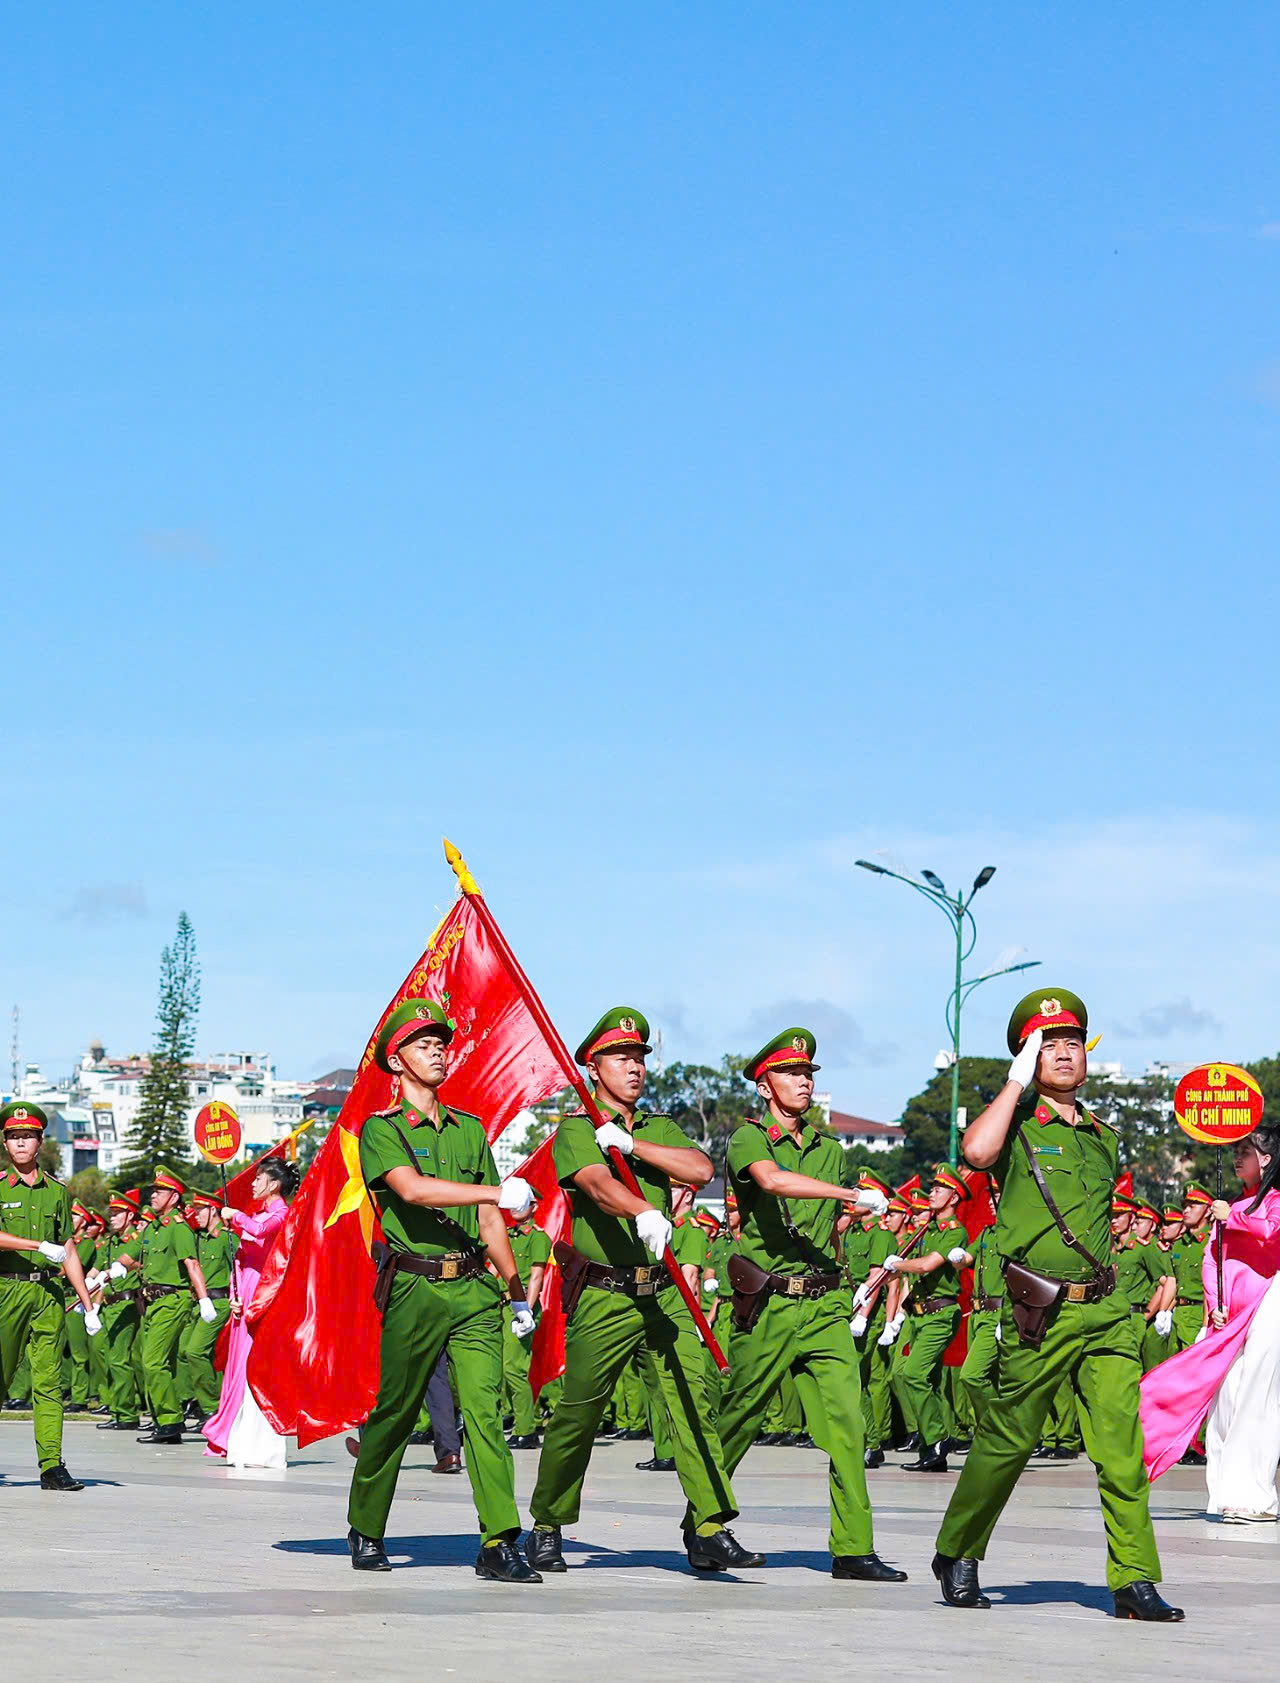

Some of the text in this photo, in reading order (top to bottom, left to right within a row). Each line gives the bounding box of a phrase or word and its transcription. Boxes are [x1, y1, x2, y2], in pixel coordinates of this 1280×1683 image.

[428, 923, 465, 971] QUỐC
[1185, 1087, 1249, 1102] CÔNG AN THÀNH PHỐ
[1185, 1103, 1251, 1125] HỒ CHÍ MINH
[204, 1132, 233, 1151] LÂM ĐỒNG
